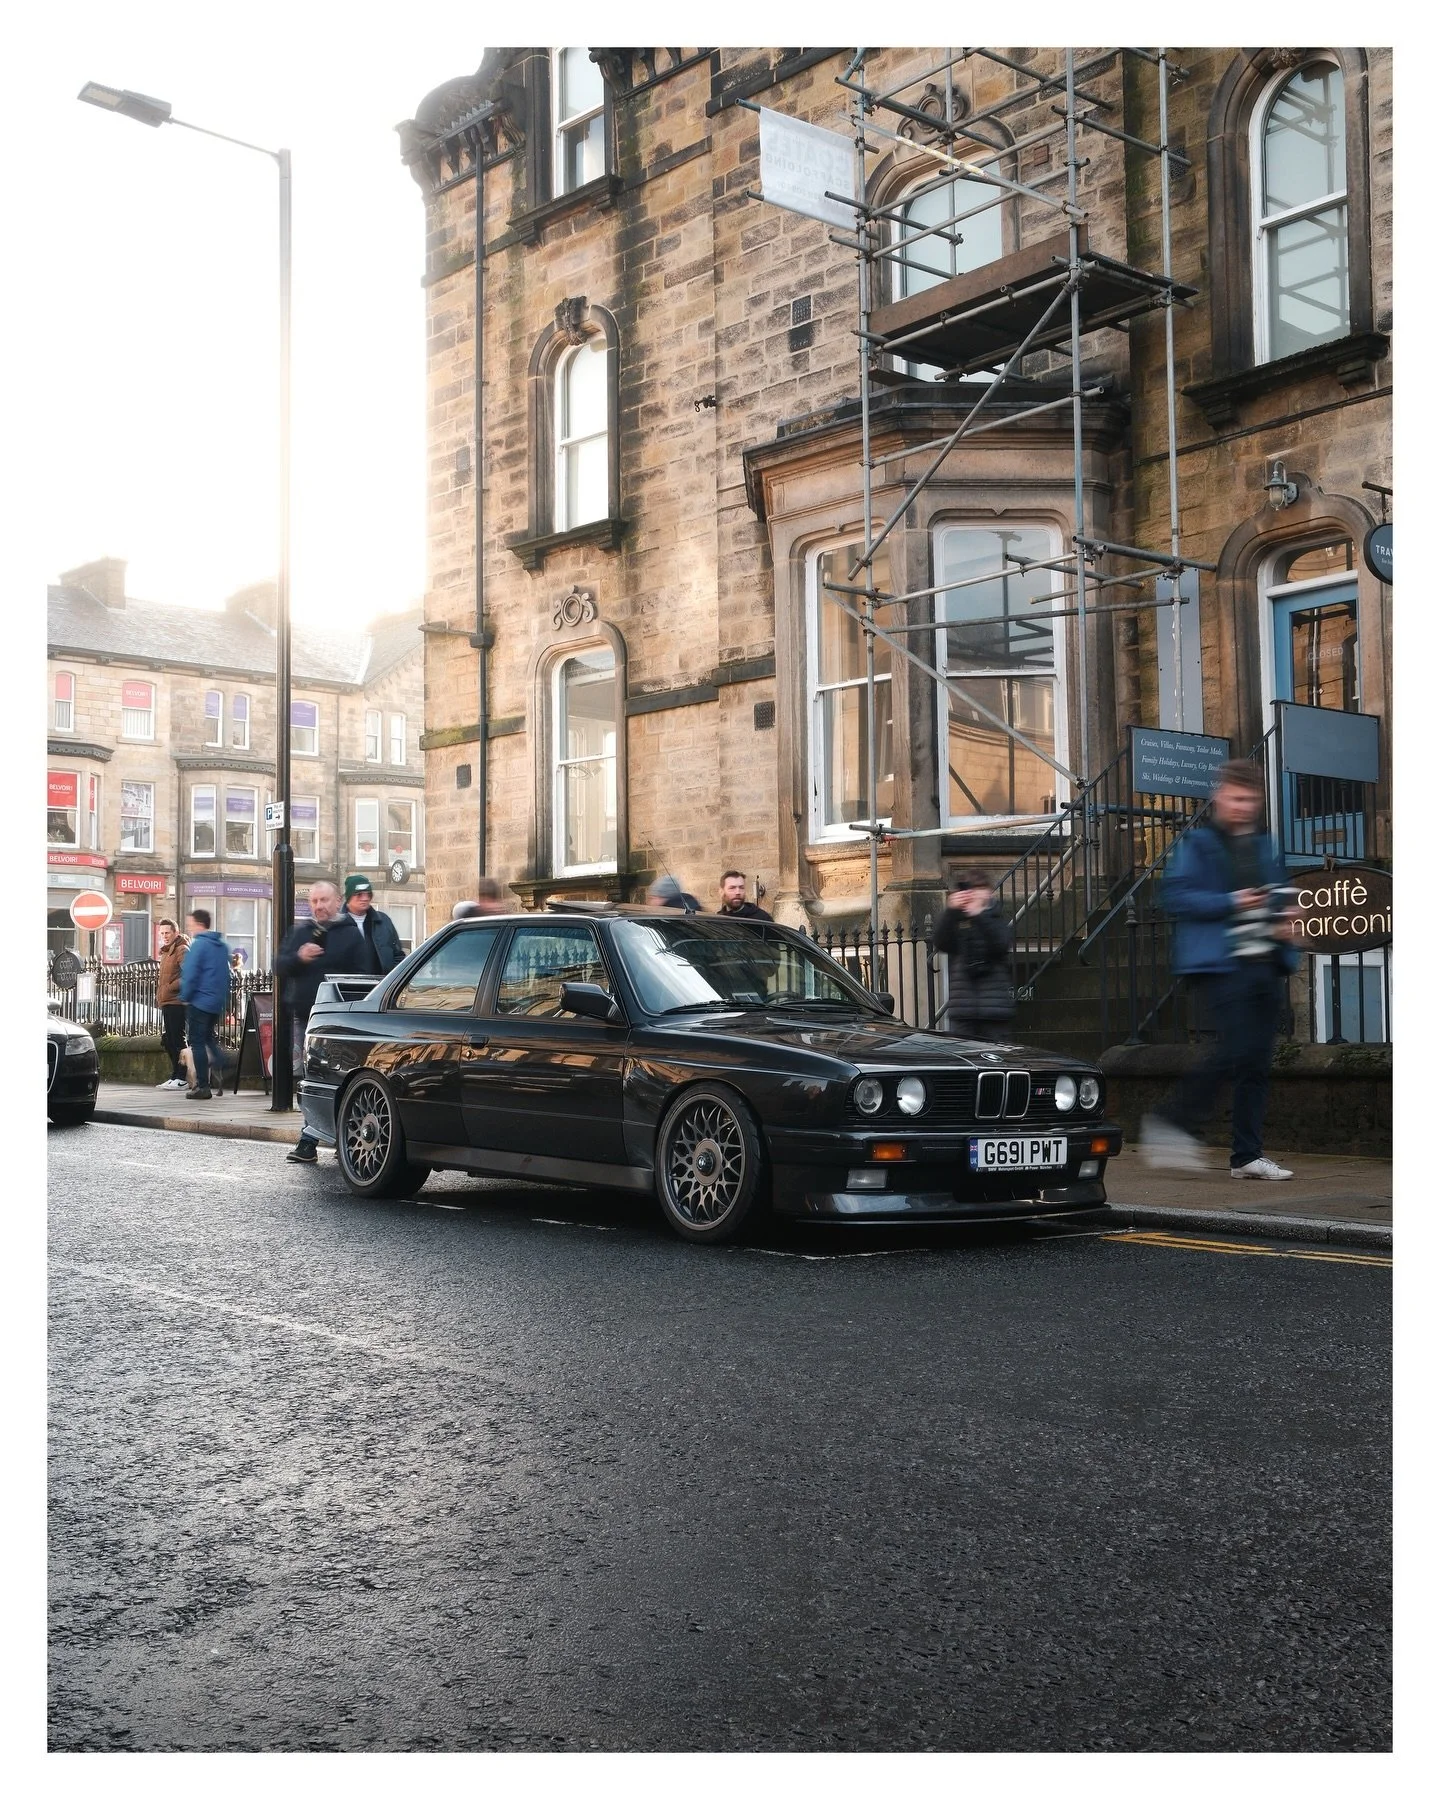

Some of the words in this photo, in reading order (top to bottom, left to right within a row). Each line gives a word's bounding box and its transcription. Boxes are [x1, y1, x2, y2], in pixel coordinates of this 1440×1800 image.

[1308, 646, 1344, 661] CLOSED
[49, 855, 78, 863] BELVOIR!
[121, 879, 162, 890] BELVOIR!
[1297, 877, 1368, 909] caffè
[131, 897, 136, 905] 3
[984, 1141, 1025, 1165] G691
[1030, 1139, 1062, 1164] PWT
